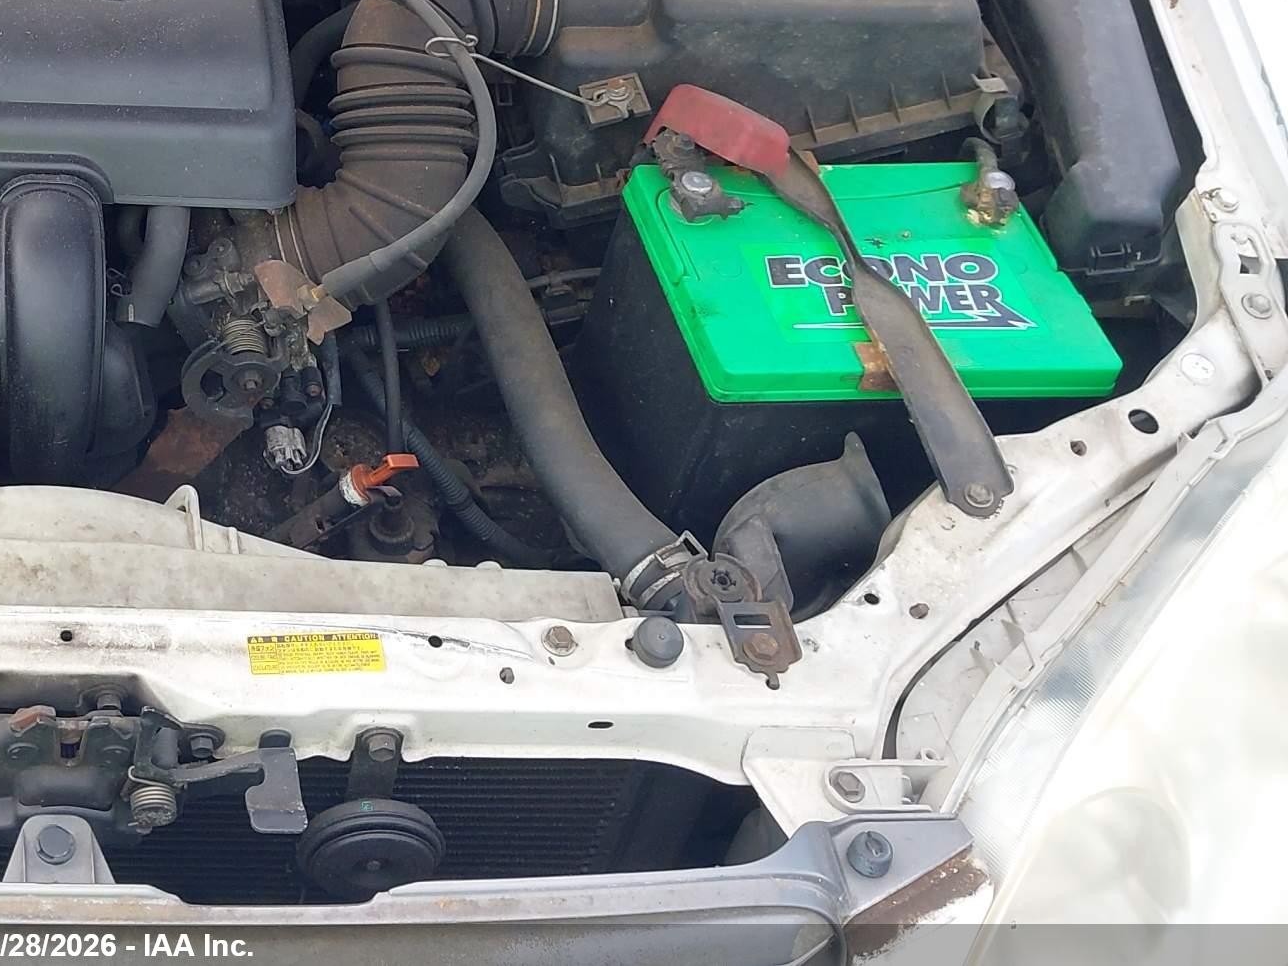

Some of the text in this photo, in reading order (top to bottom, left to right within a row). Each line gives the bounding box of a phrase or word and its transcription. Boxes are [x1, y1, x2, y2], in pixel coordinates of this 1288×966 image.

[822, 283, 1004, 315] PWER
[284, 635, 325, 643] CAUTION
[331, 633, 377, 641] ATTENTION
